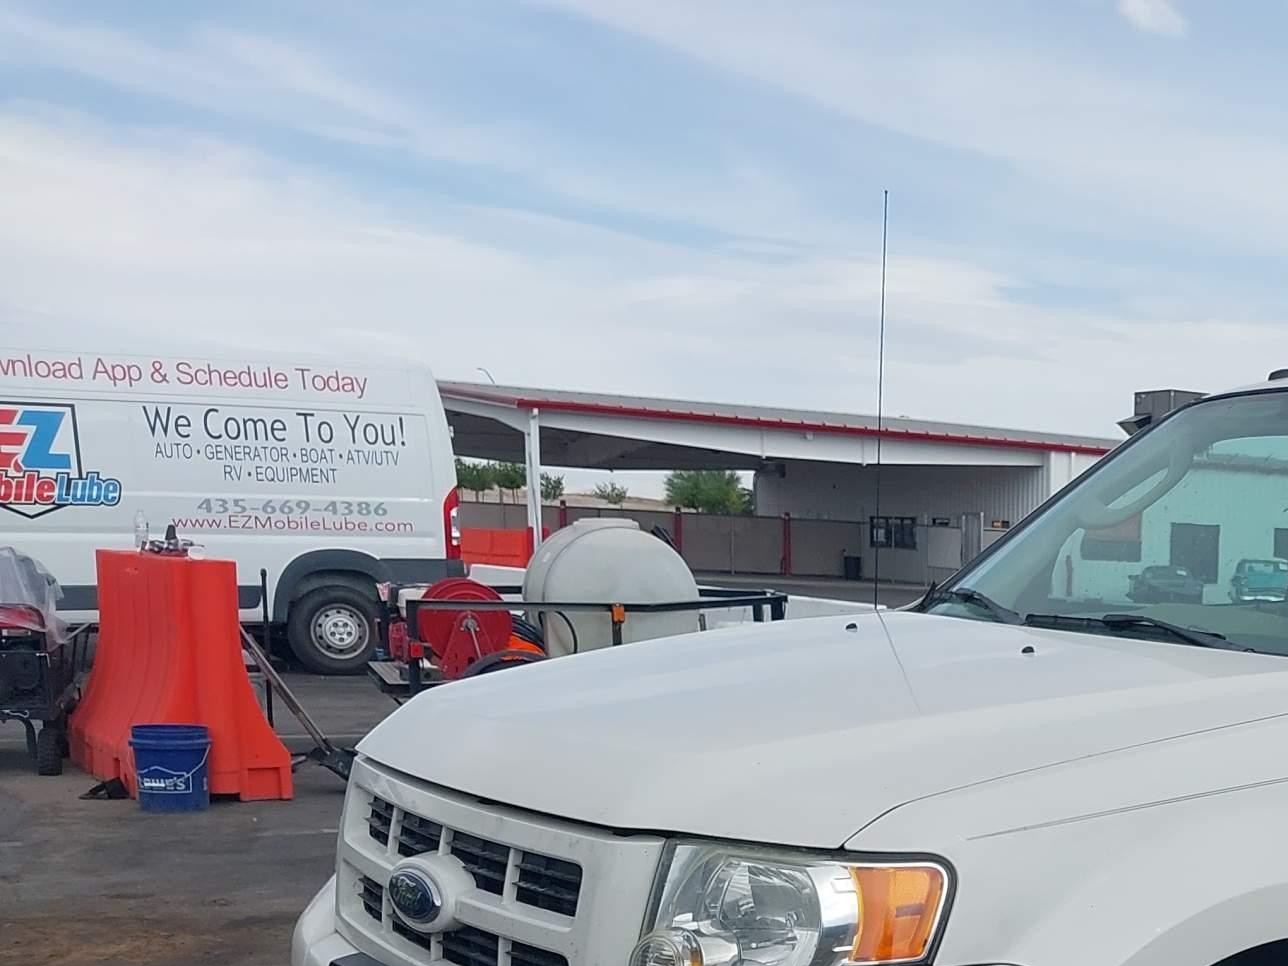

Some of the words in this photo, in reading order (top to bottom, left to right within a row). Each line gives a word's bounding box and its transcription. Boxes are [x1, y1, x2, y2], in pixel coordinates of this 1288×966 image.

[92, 357, 142, 387] App
[150, 360, 170, 384] &
[175, 361, 289, 390] Schedule
[295, 367, 367, 399] Today
[142, 405, 192, 438] We
[203, 408, 287, 442] Come
[296, 412, 334, 444] To
[343, 413, 406, 447] You!
[155, 442, 193, 460] AUTO
[204, 444, 290, 463] GENERATOR
[300, 447, 335, 465] BOAT
[223, 464, 242, 481] RV
[255, 465, 338, 484] EQUIPMENT
[197, 498, 388, 517] 435-669-4386
[172, 514, 414, 532] www.EZMobileLube.com
